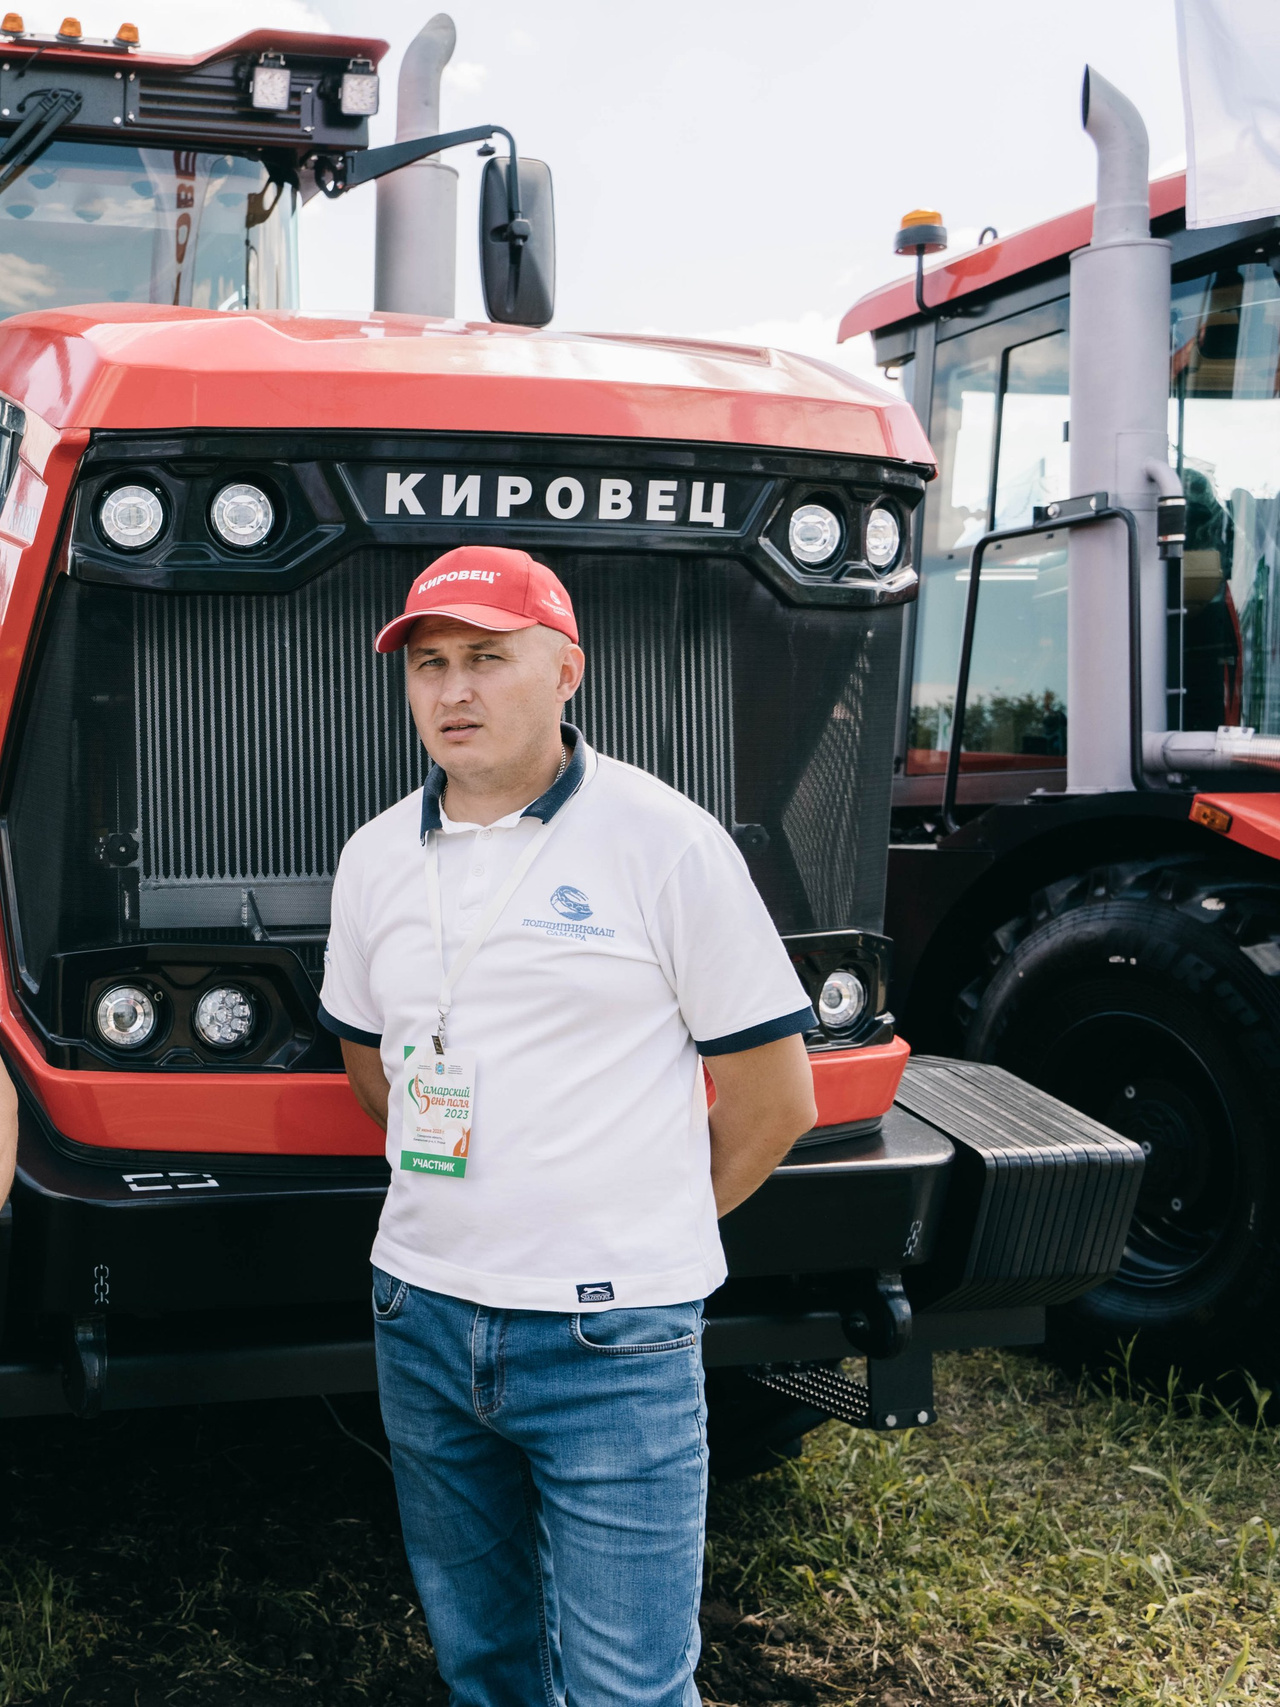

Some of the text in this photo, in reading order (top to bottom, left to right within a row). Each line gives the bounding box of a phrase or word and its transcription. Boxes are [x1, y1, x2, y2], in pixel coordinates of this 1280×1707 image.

[384, 472, 726, 528] КИРОВЕЦ
[417, 570, 495, 594] КИРОВЕЦ
[522, 918, 616, 938] ПОДШИПНИКМАШ
[546, 929, 587, 941] САМАРА
[444, 1108, 469, 1120] 2023
[412, 1157, 455, 1173] УЧАСТНИК
